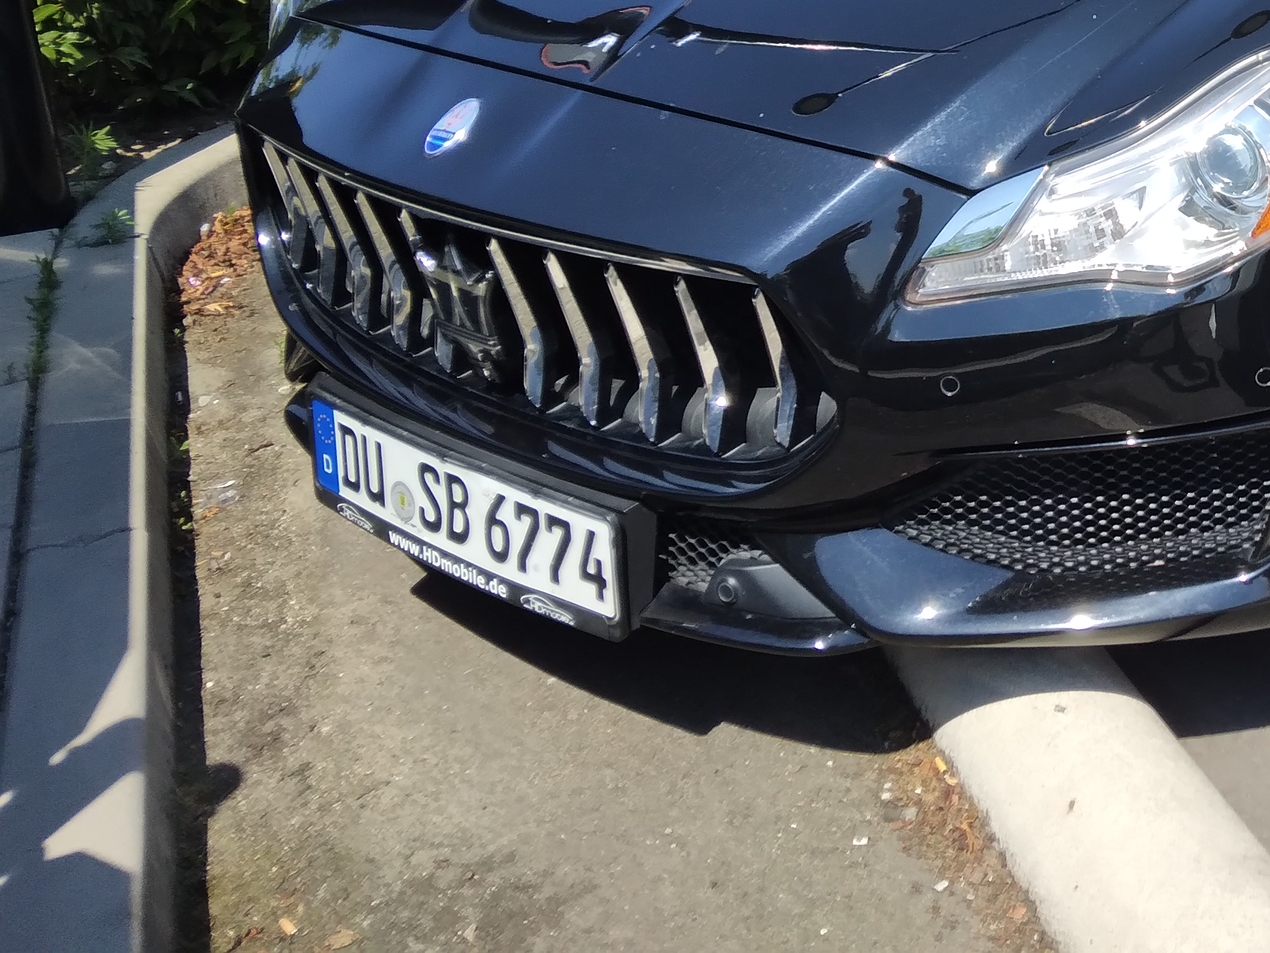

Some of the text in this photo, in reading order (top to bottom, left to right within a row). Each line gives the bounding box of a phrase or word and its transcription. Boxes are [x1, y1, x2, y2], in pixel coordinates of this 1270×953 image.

[322, 453, 333, 475] D
[338, 422, 387, 511] DU
[417, 460, 471, 547] SB
[485, 493, 608, 603] 6774
[388, 530, 508, 600] www.HDmobile.de
